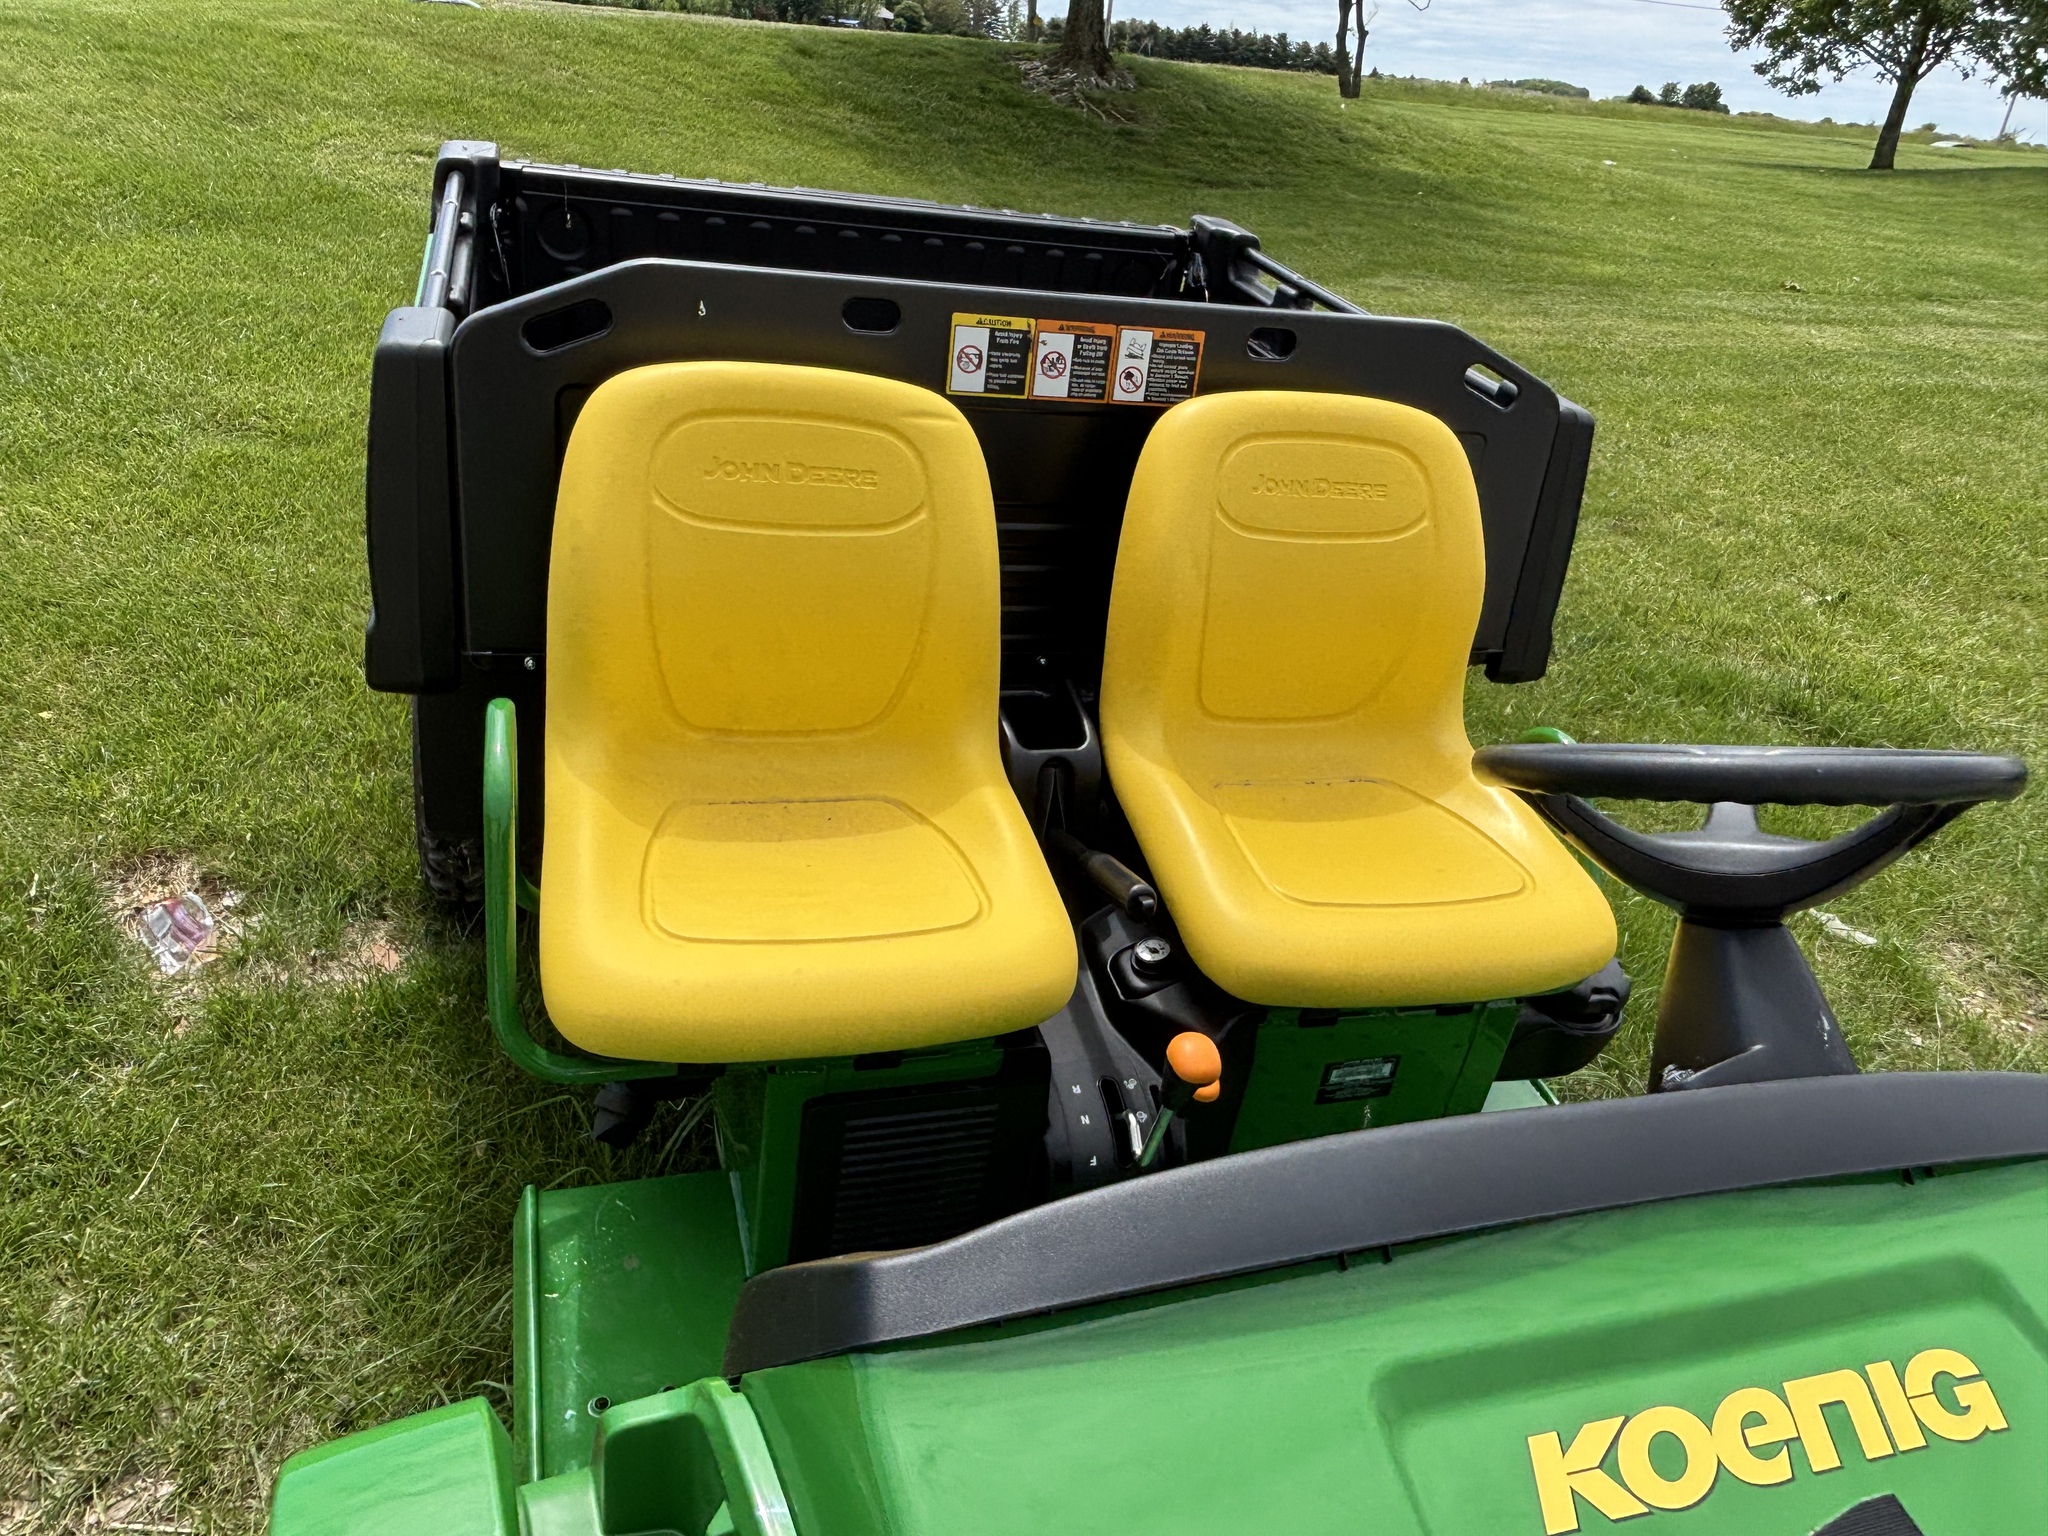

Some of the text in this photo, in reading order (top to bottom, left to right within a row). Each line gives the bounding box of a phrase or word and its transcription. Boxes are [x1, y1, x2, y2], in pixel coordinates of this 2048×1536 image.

[983, 318, 1012, 327] CAUTION
[703, 455, 879, 490] JOHN DEERE
[1251, 473, 1388, 501] JOHN DEERE
[1071, 1084, 1081, 1094] R
[1081, 1115, 1090, 1124] N
[1089, 1155, 1097, 1166] F
